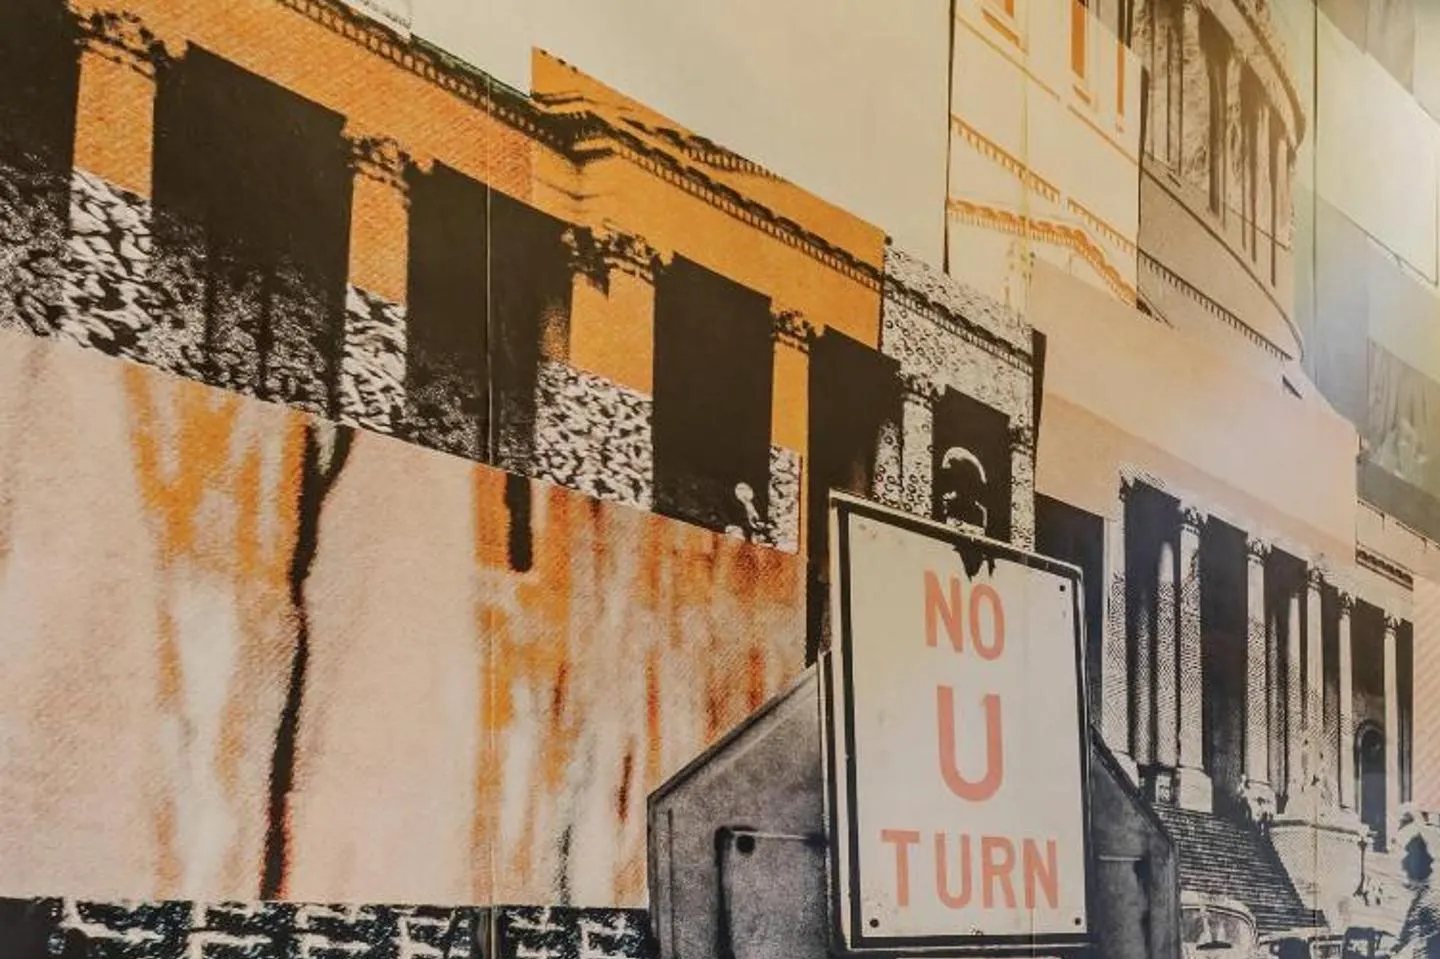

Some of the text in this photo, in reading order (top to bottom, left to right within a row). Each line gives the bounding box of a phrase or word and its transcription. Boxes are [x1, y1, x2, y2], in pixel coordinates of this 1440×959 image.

[923, 570, 1006, 661] NO
[935, 684, 1004, 802] U
[881, 828, 1060, 911] TURN
